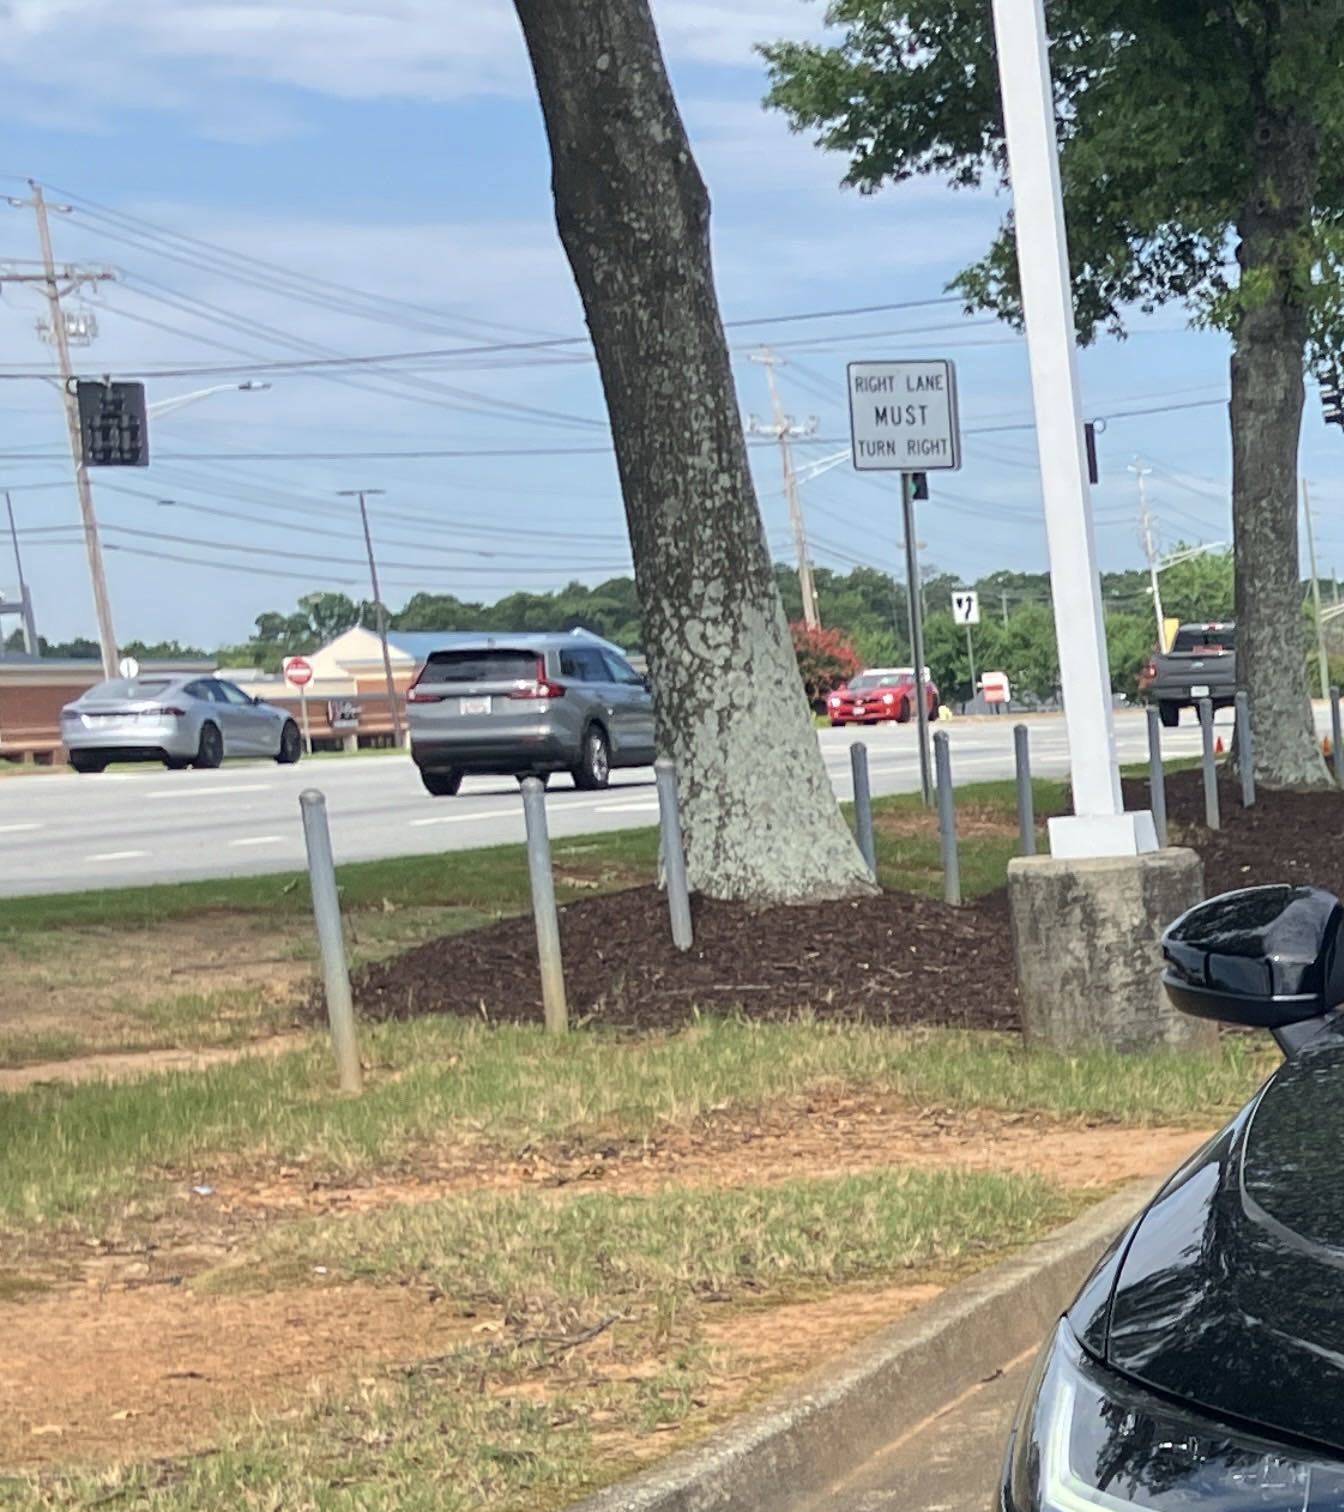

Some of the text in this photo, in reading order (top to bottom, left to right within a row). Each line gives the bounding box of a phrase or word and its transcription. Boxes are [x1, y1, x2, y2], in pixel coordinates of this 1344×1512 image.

[855, 374, 944, 393] RIGHT LANE
[874, 405, 928, 426] MUST
[858, 439, 948, 457] TURN RIGHT
